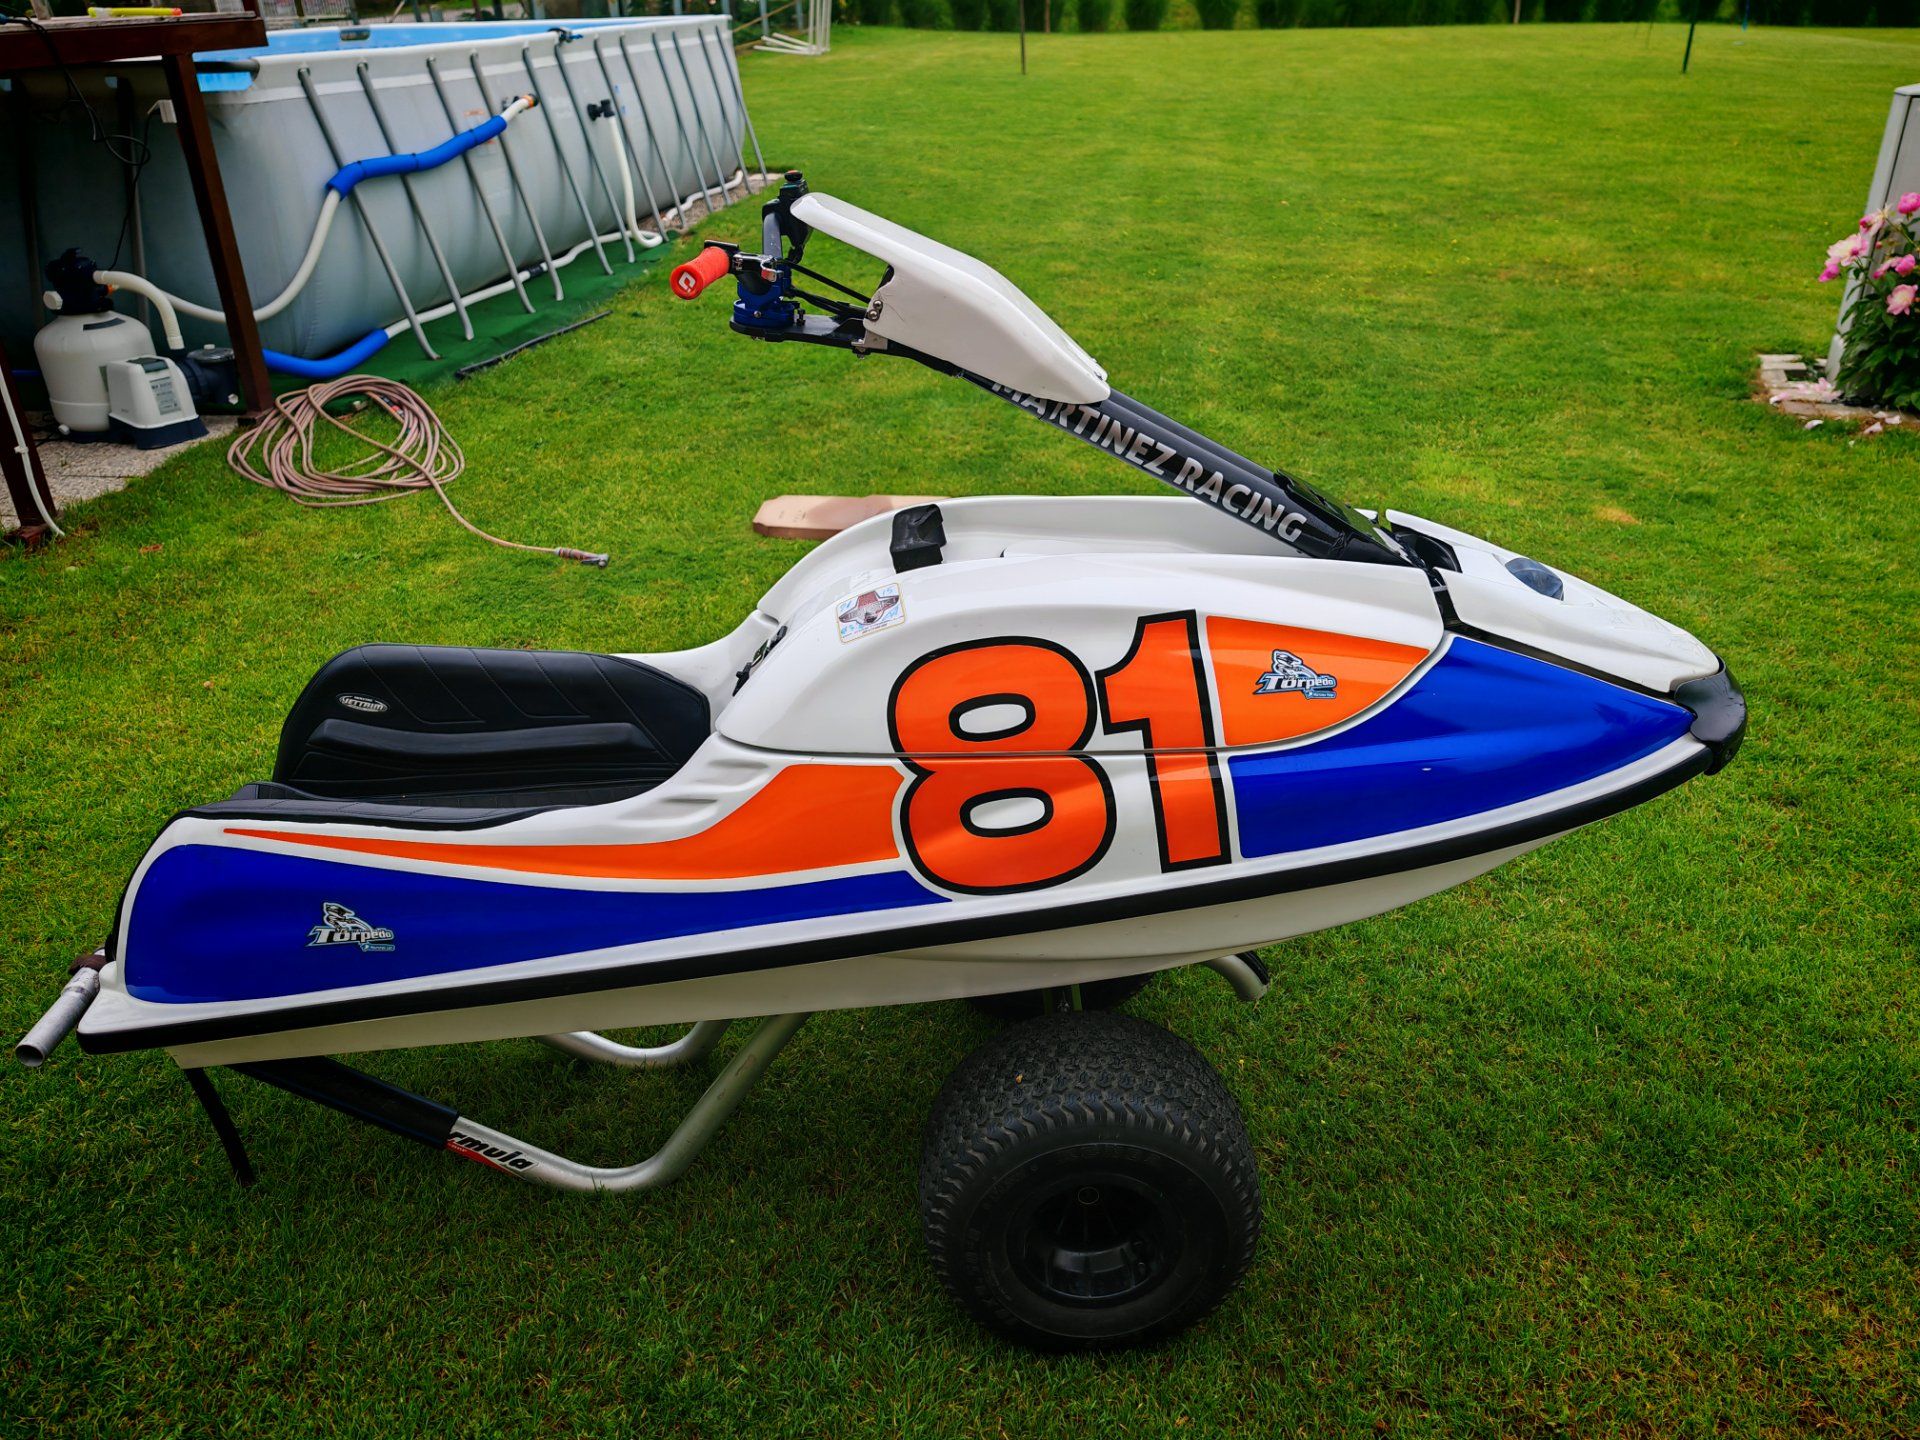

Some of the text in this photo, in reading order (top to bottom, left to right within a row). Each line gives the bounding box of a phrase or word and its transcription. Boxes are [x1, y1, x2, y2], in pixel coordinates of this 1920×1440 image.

[1173, 457, 1308, 543] RACING
[1265, 674, 1334, 690] Torpedo
[887, 609, 1232, 896] 81
[316, 928, 392, 943] Torpedo
